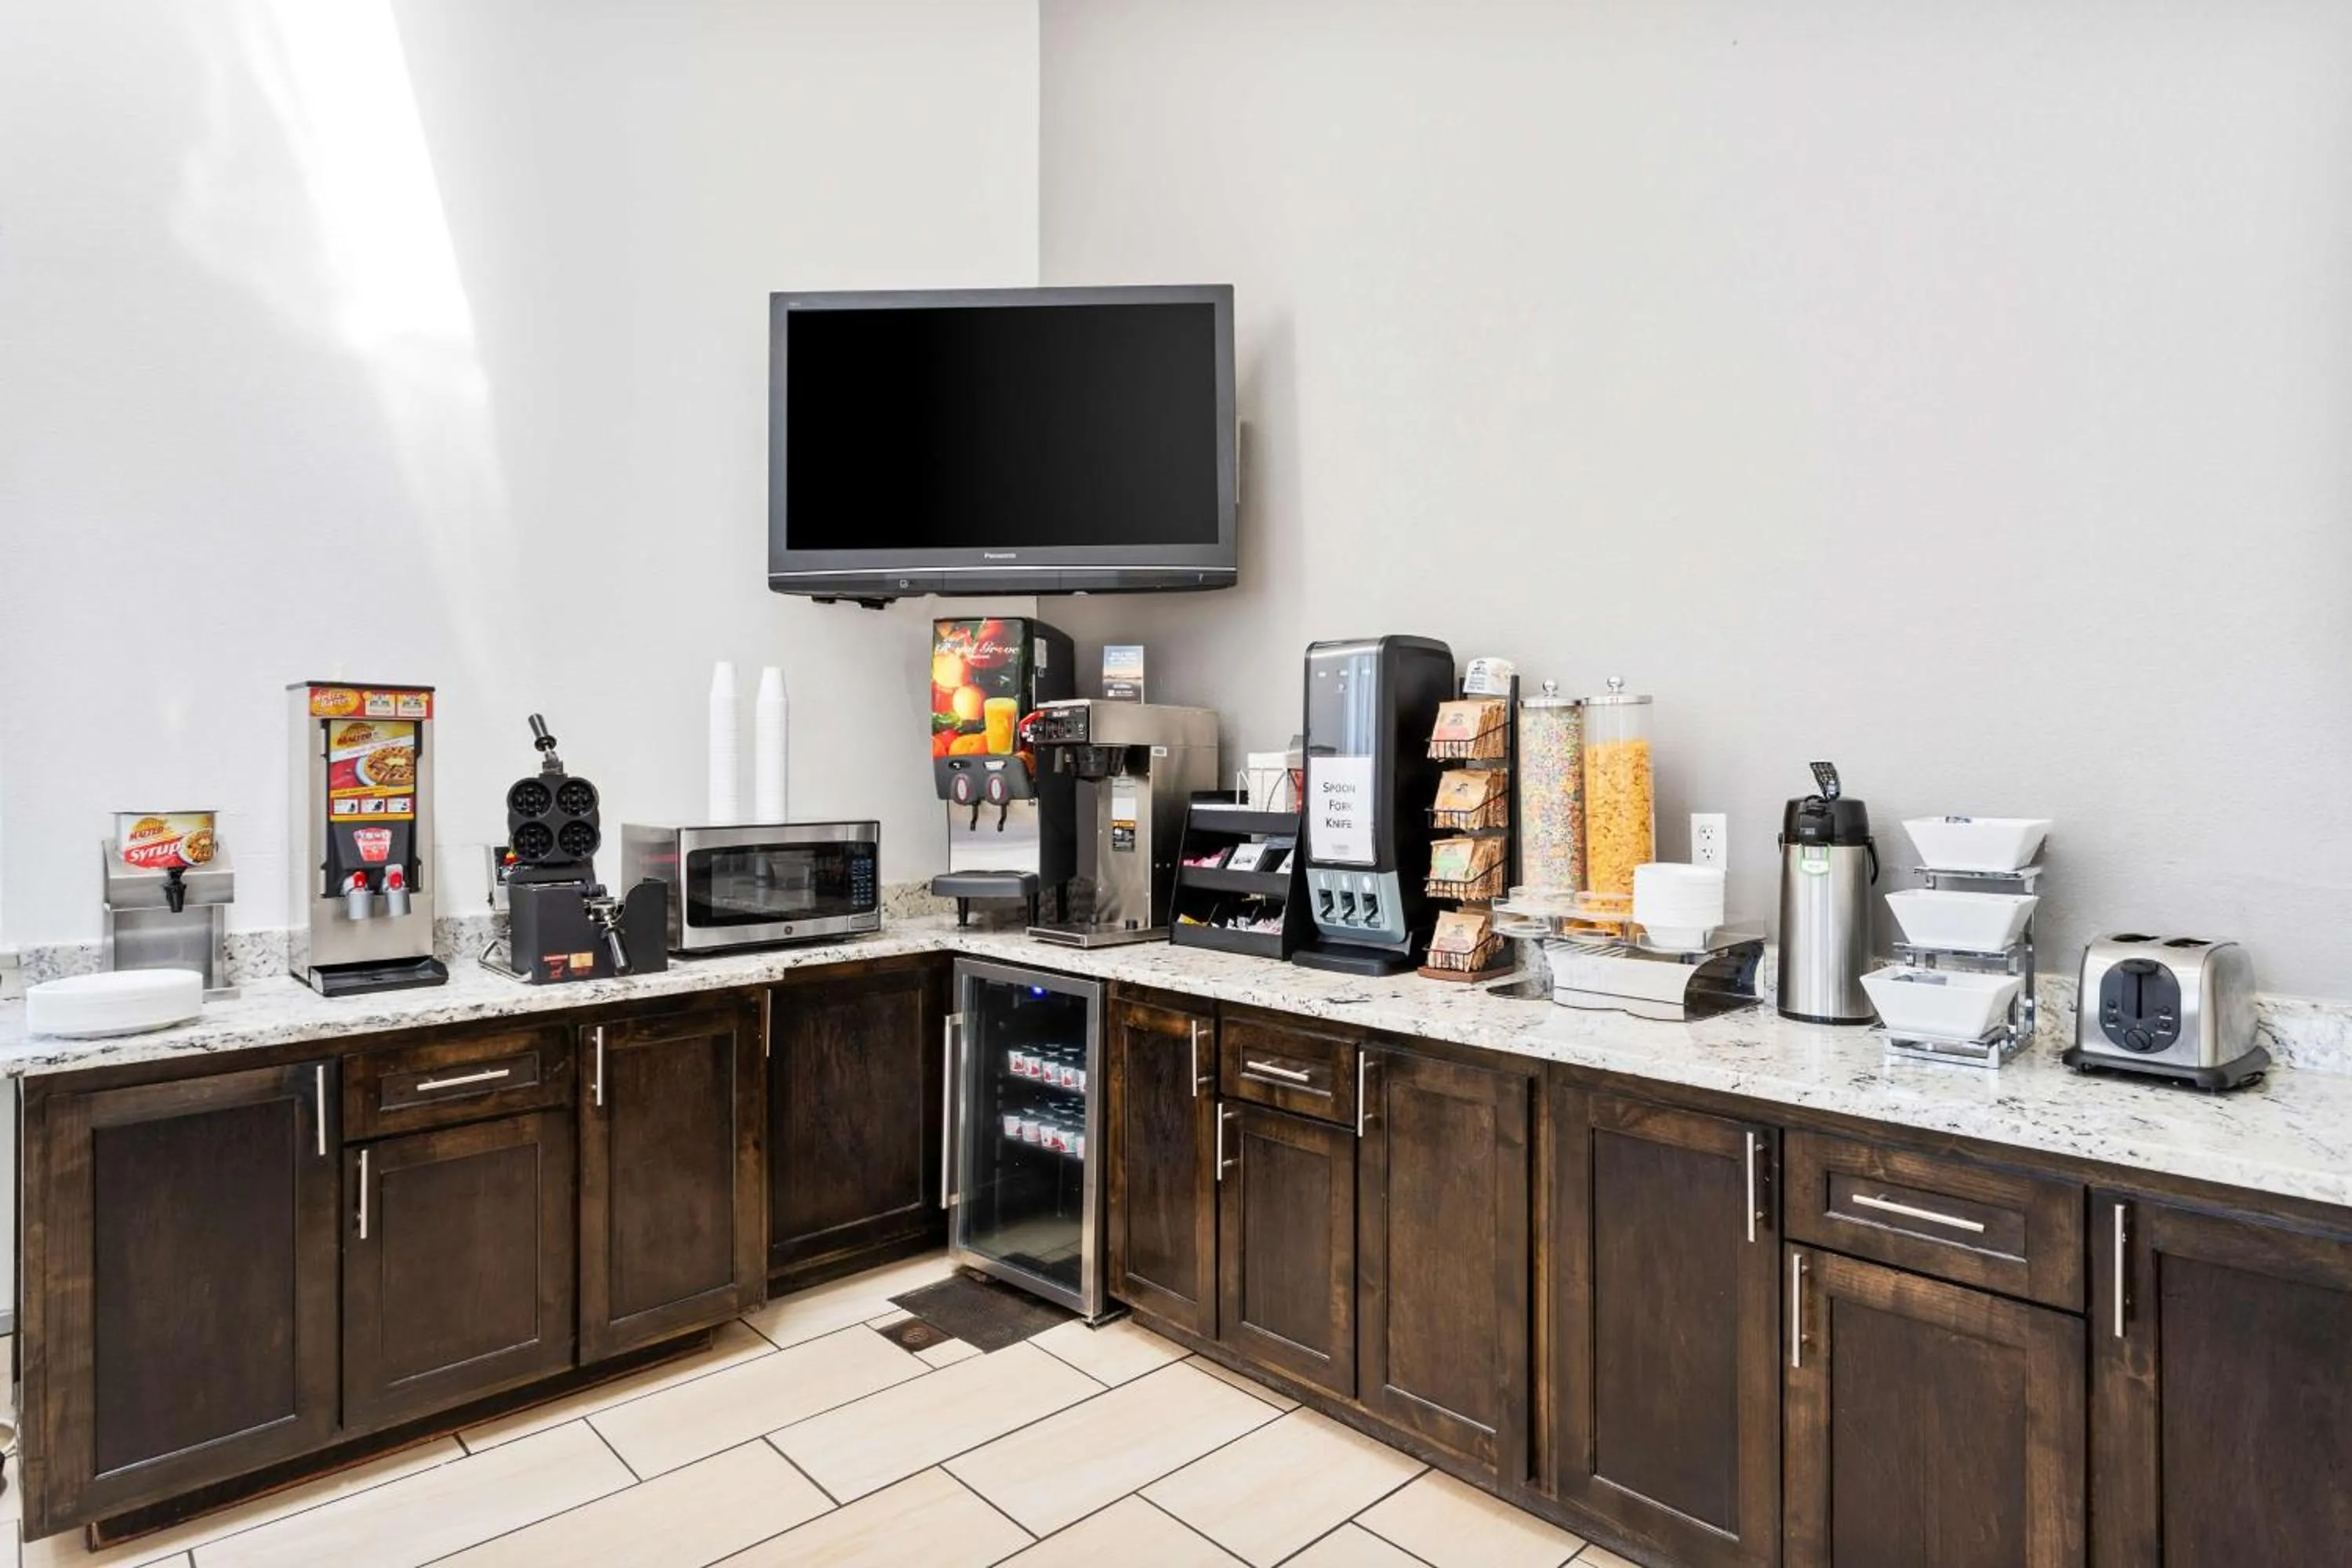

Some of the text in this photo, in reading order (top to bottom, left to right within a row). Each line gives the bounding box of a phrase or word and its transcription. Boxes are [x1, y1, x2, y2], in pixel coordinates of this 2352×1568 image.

[1323, 782, 1356, 793] SPOON
[1329, 799, 1352, 811] FORK
[1326, 818, 1352, 829] KNIFE
[129, 840, 182, 863] Syrup
